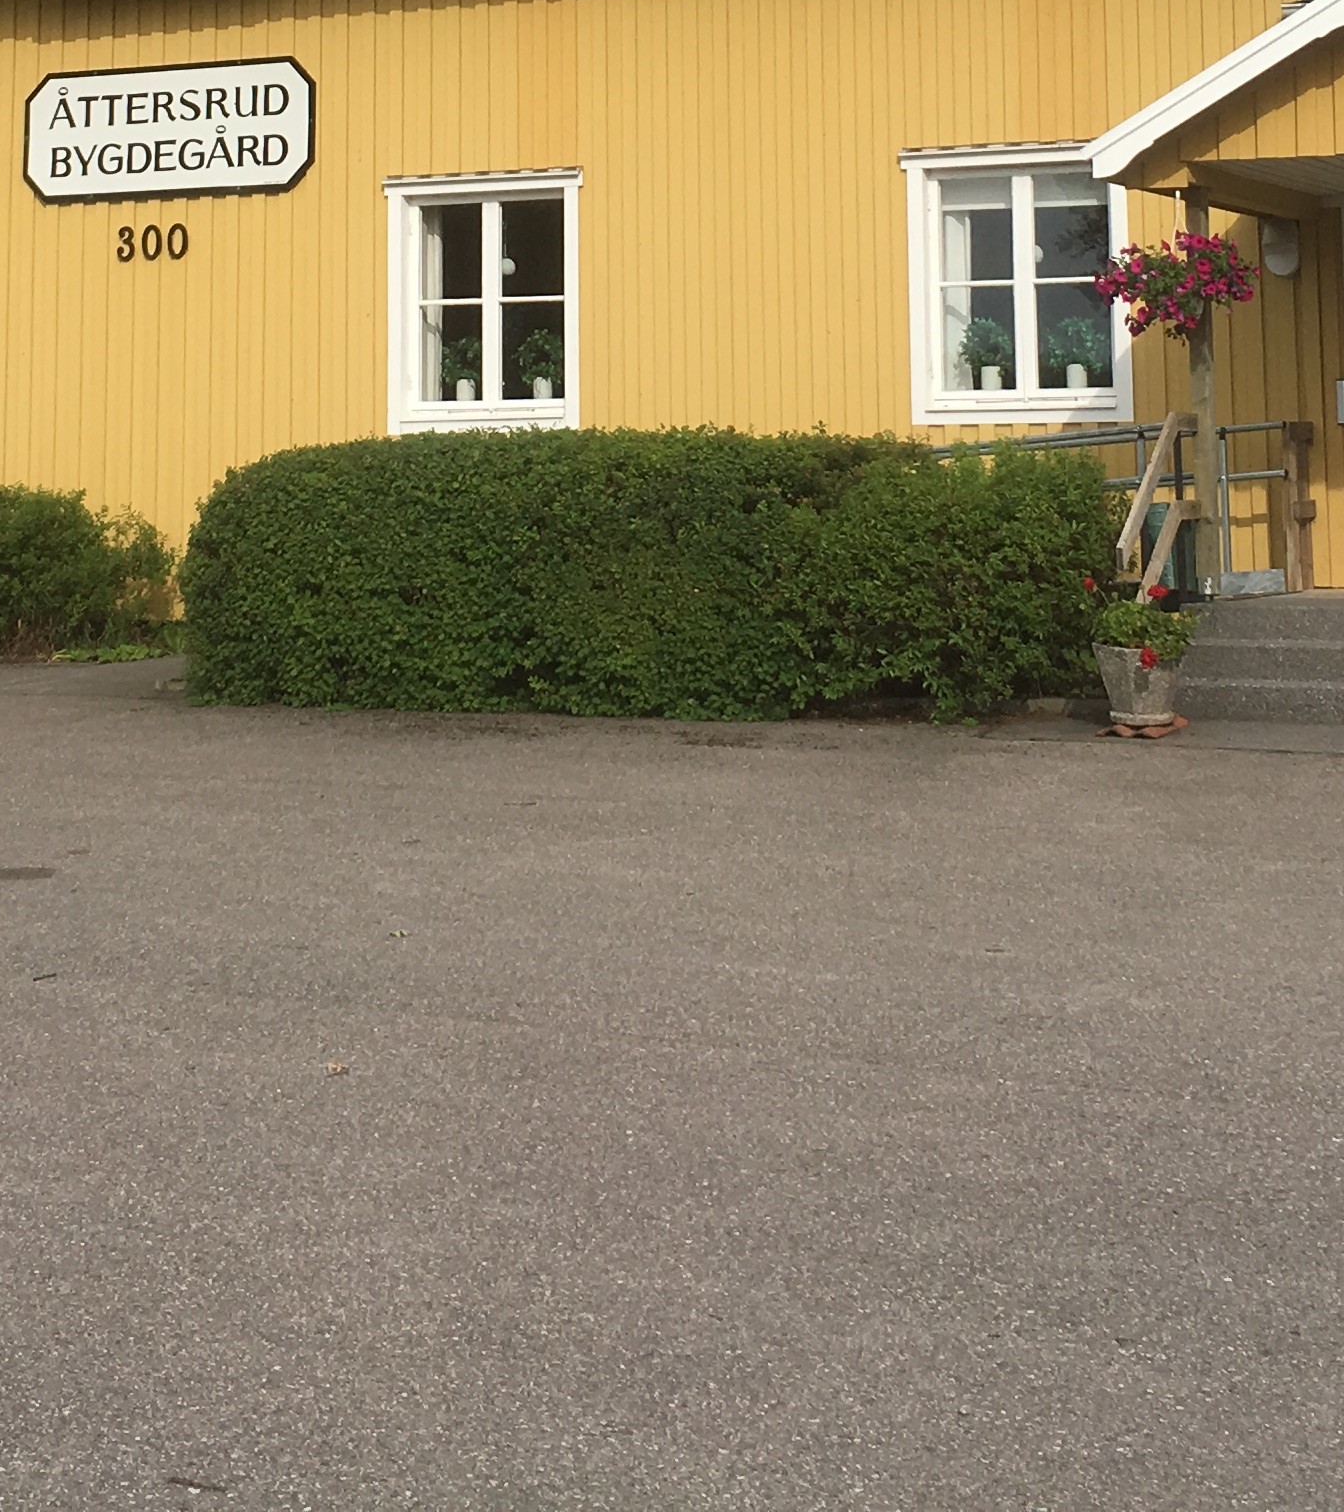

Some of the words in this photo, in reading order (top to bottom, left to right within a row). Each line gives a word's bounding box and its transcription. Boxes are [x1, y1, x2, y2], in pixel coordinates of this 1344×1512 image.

[49, 83, 290, 130] ÅTTERSRUD
[50, 125, 289, 178] BYGDEGÅRD
[116, 222, 189, 263] 300
